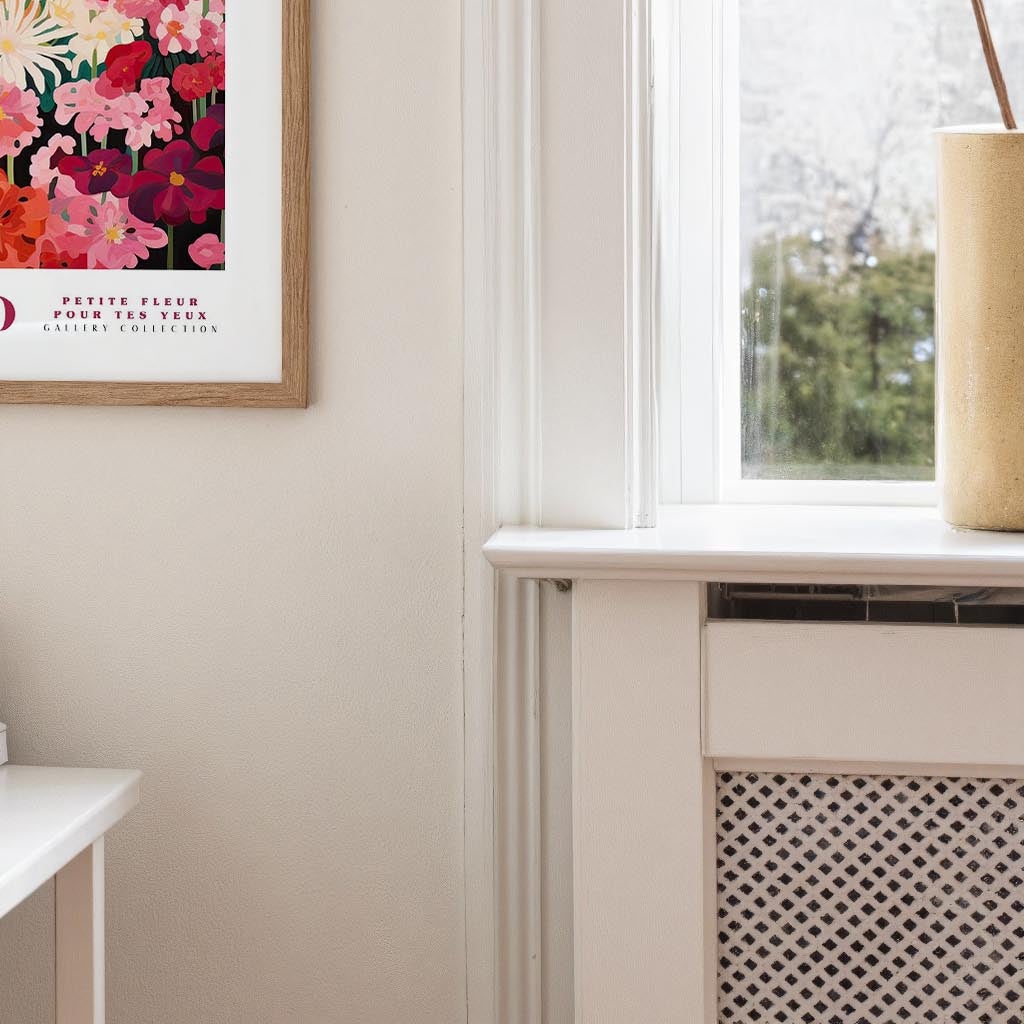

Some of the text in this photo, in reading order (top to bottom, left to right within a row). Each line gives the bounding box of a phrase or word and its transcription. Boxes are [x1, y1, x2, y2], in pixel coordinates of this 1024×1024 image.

[62, 296, 198, 307] PETITE FLEUR
[53, 310, 207, 321] POUR TES YEUX
[43, 323, 218, 334] GALLERY COLLECTION
